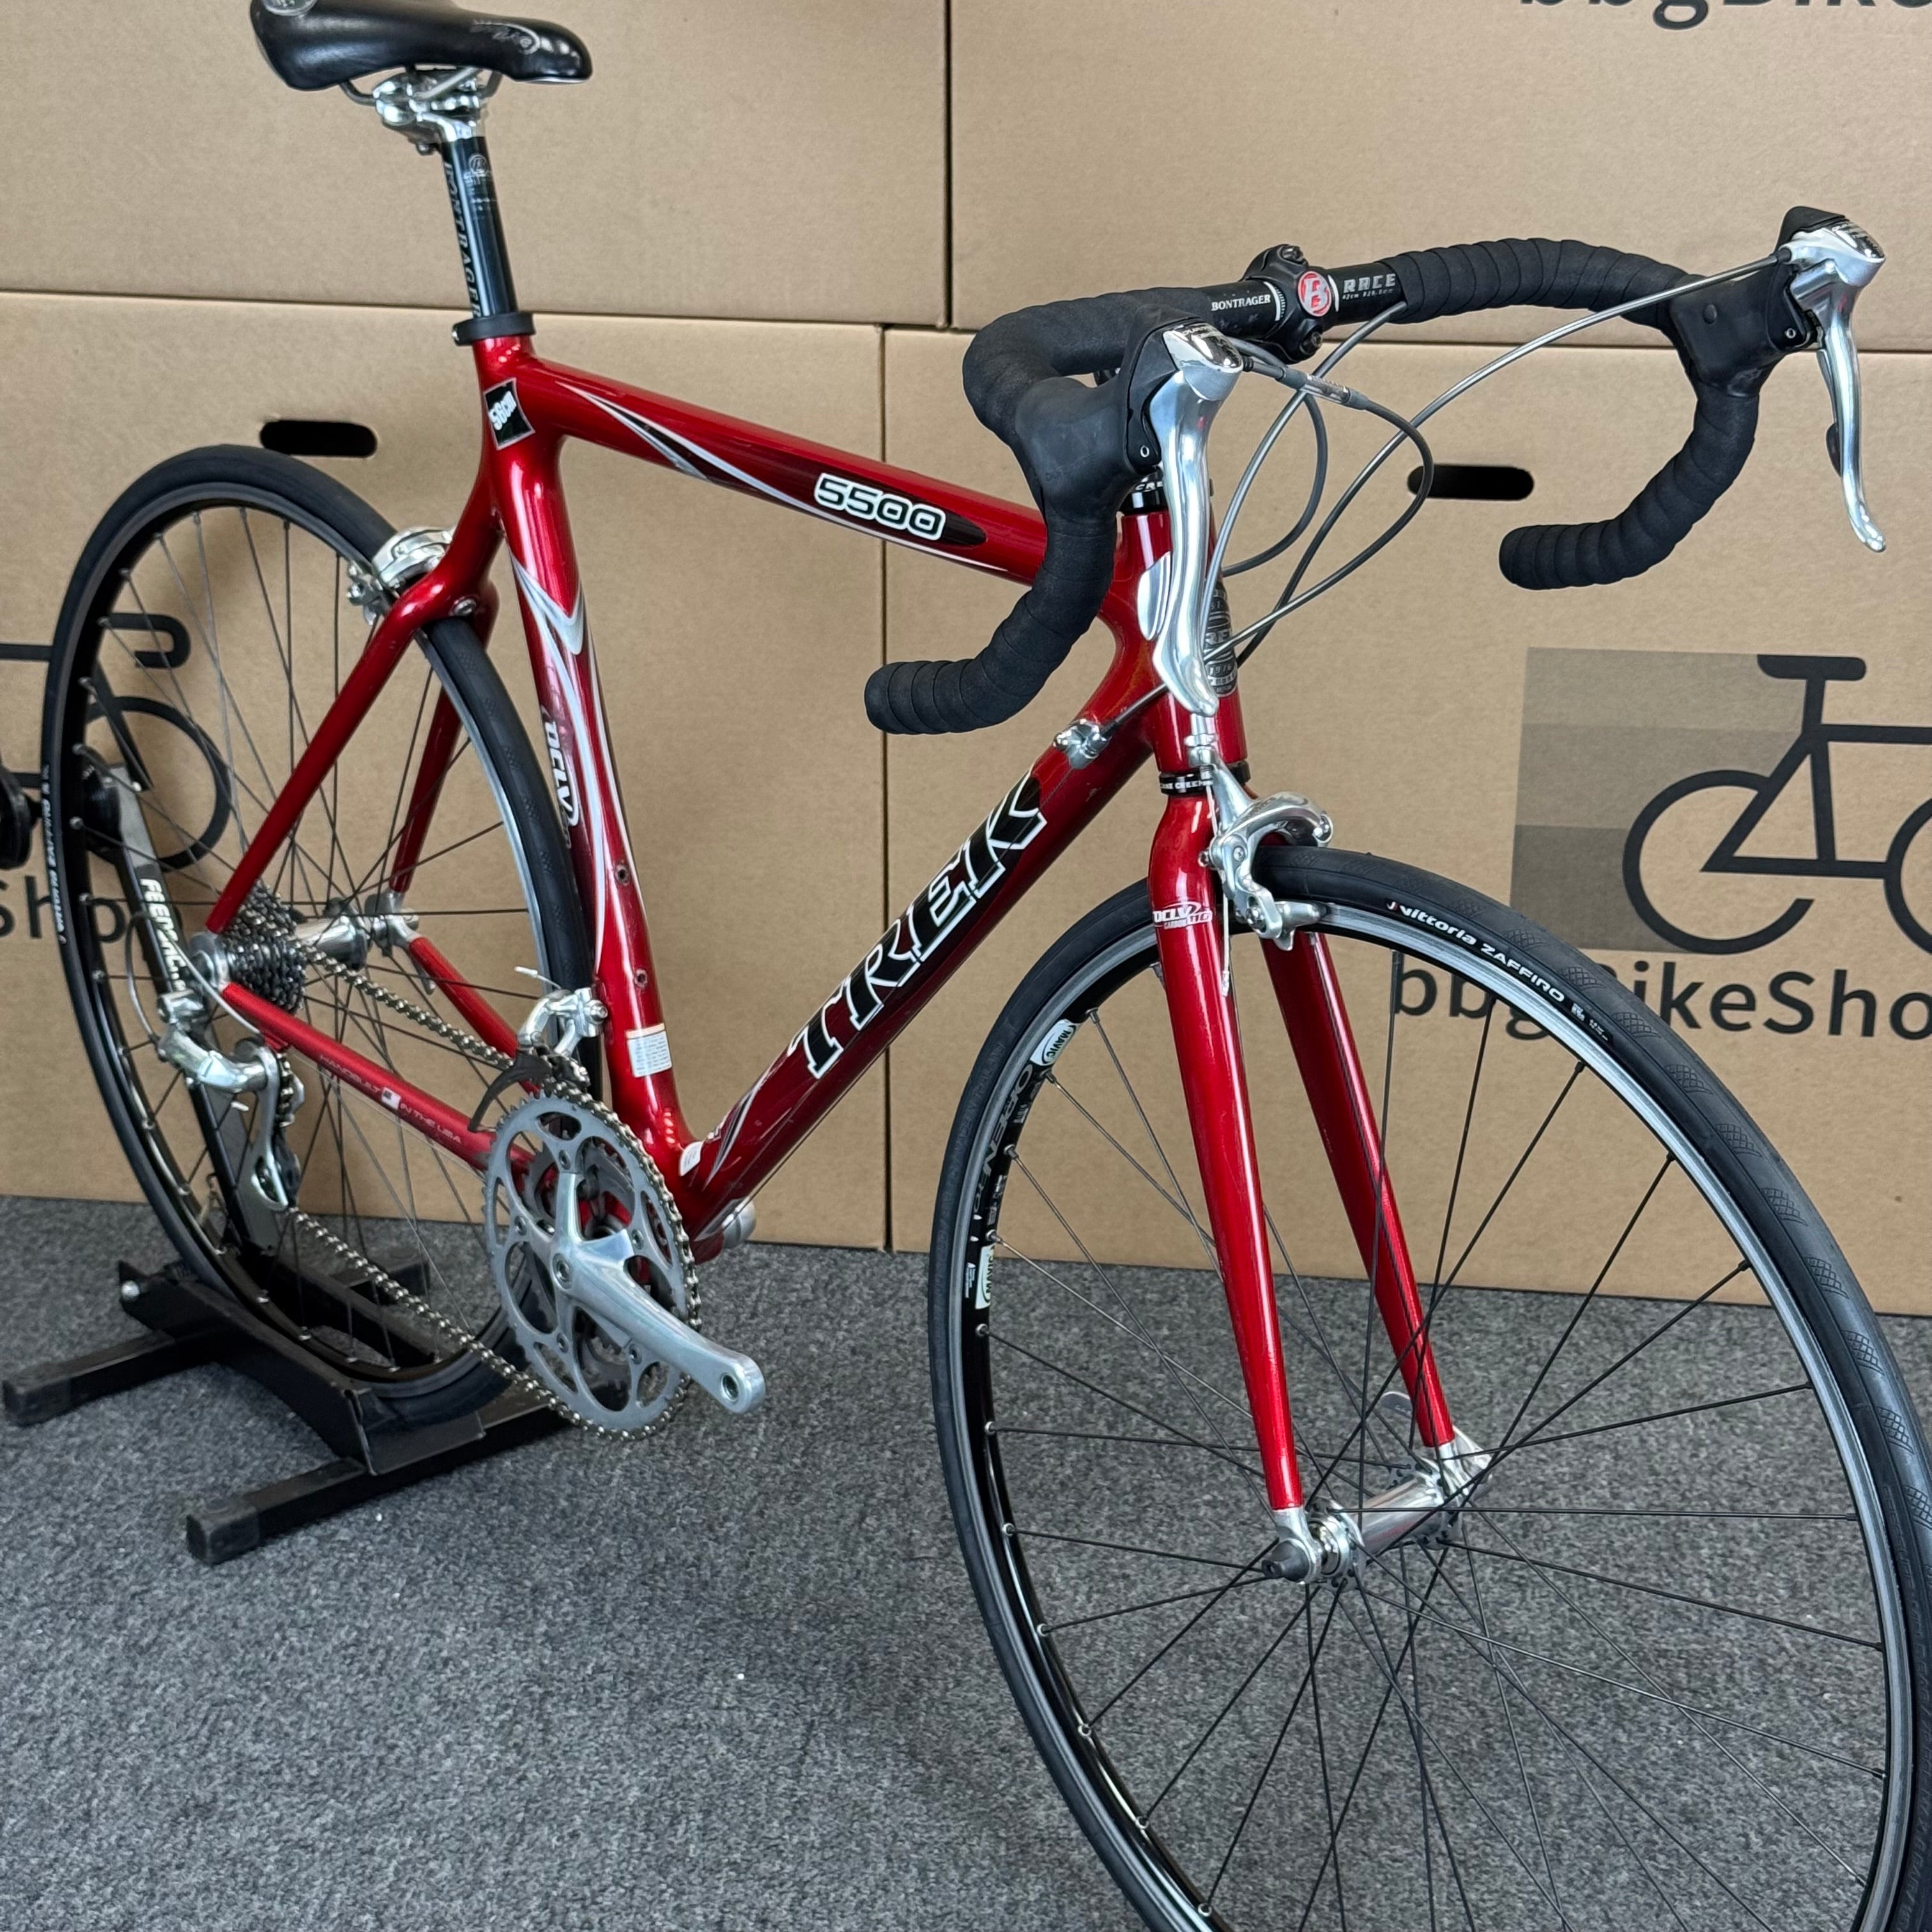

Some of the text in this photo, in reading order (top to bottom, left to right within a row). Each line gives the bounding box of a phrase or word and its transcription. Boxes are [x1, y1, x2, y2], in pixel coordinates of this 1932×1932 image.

[1211, 293, 1271, 311] BONTRAGER
[1343, 273, 1397, 294] RACE
[487, 390, 517, 431] 56cm
[813, 472, 946, 540] 5500
[788, 763, 1048, 1079] TREK
[1480, 942, 1565, 1003] ZAFFIRO
[1046, 1029, 1072, 1058] MAVIC
